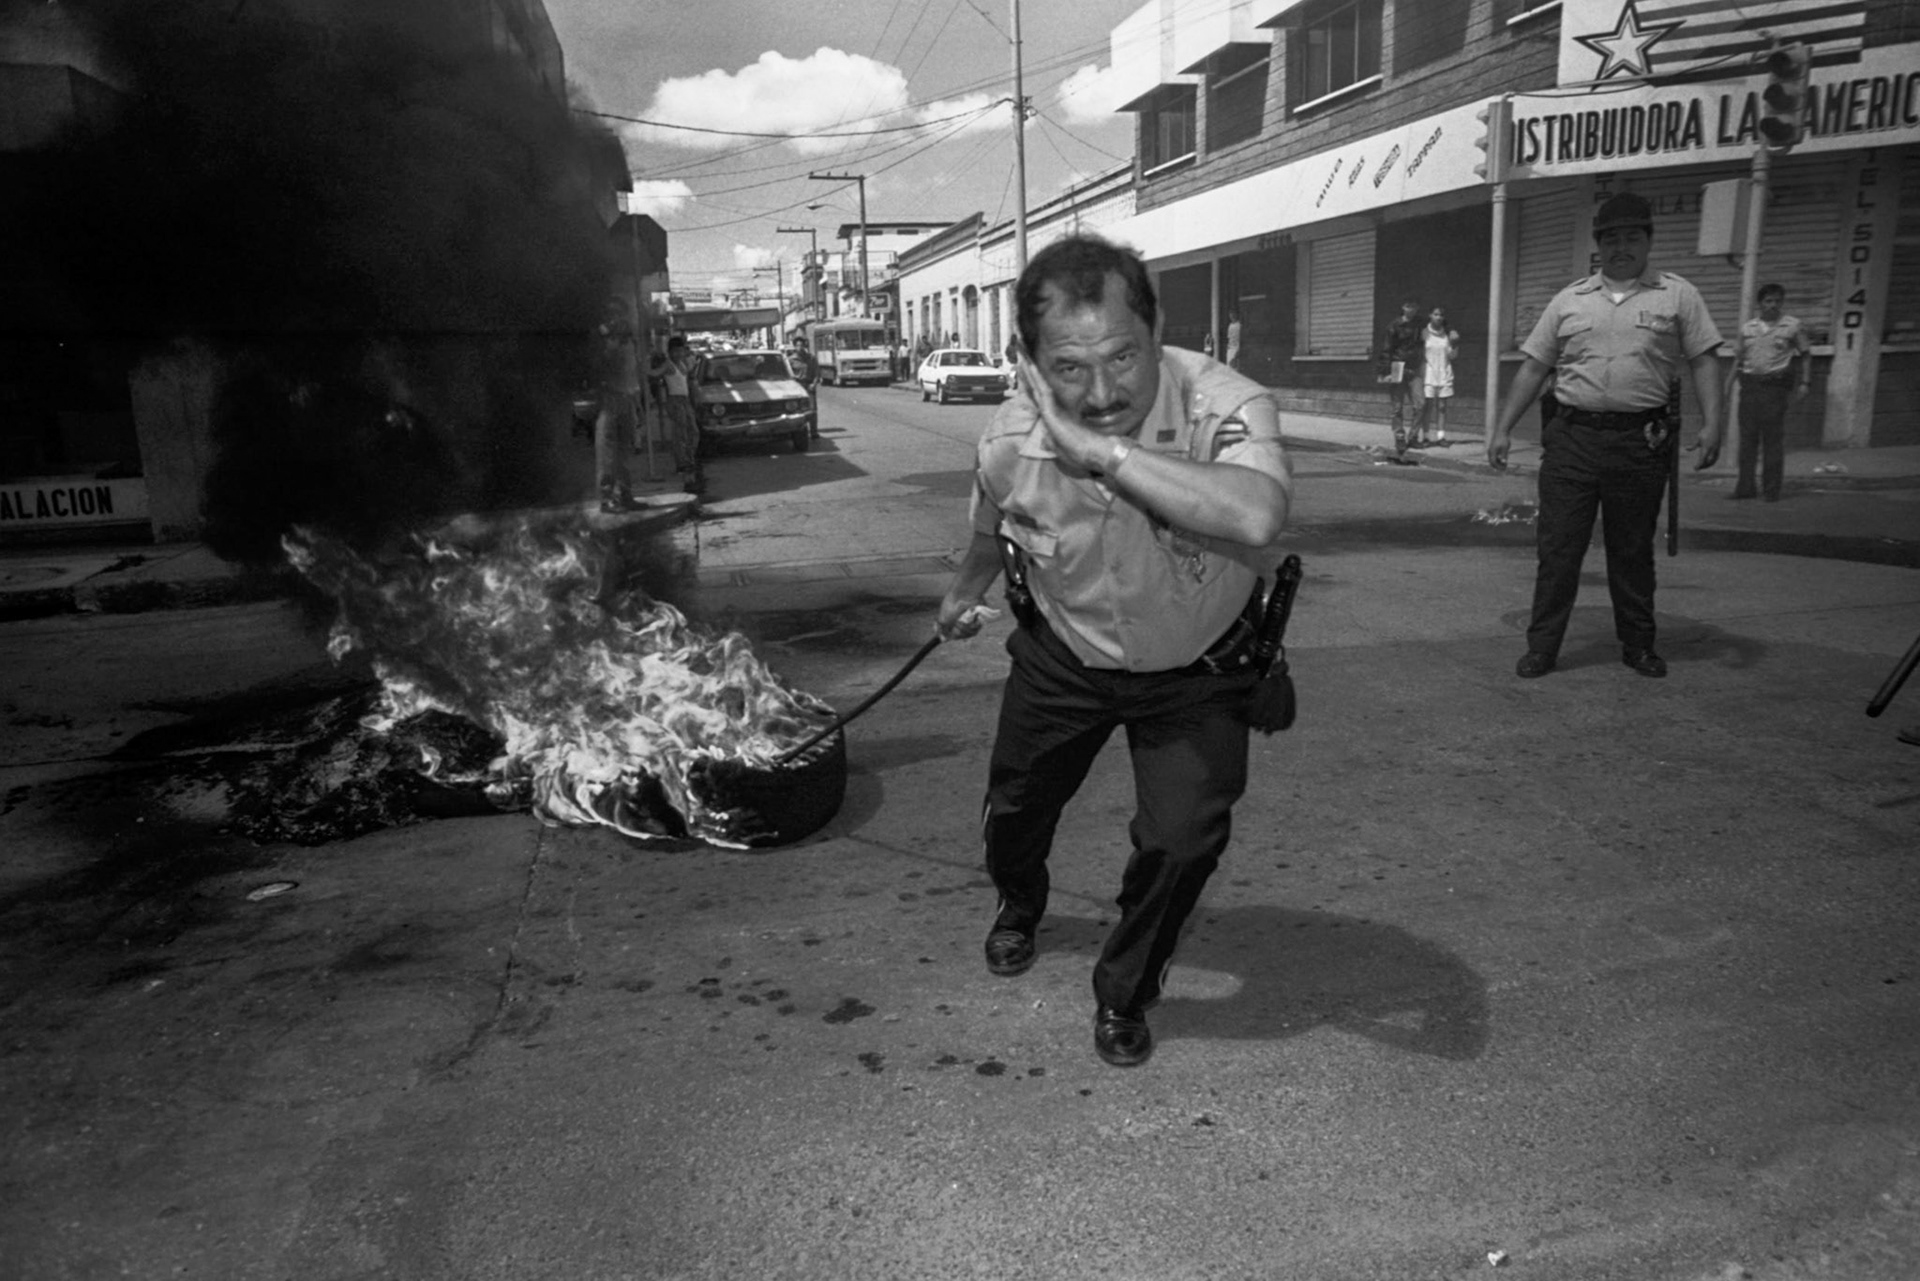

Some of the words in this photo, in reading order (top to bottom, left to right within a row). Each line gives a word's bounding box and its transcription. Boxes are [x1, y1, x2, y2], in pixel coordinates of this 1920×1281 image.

[1511, 98, 1704, 166] ISTRIBUIDORA
[1717, 91, 1759, 141] LA
[0, 486, 113, 520] ALACION
